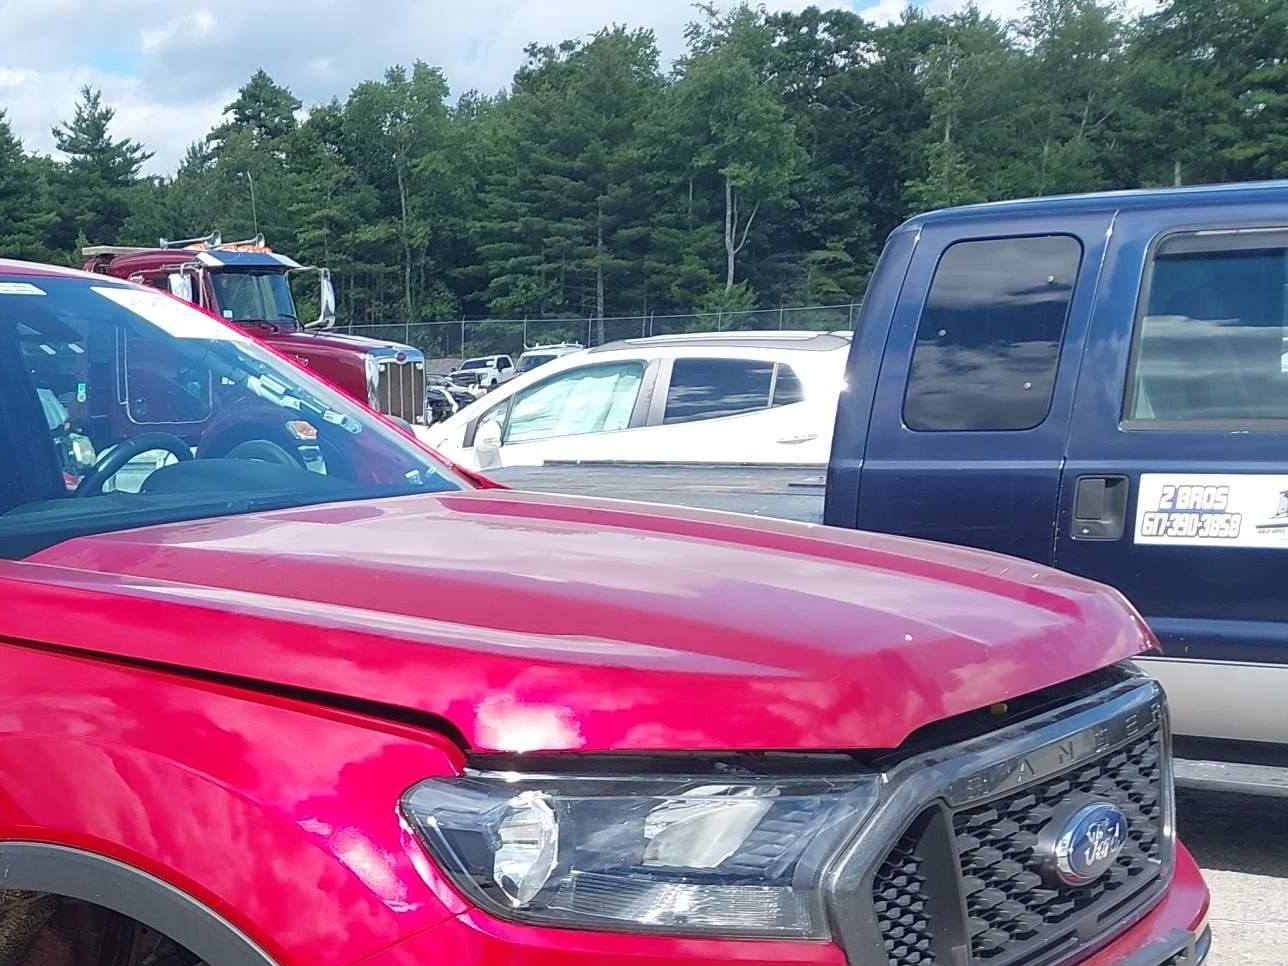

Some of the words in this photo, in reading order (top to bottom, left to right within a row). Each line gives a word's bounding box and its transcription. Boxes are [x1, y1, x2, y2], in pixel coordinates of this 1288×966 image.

[1159, 484, 1176, 511] 2
[1175, 484, 1230, 511] BROS
[1084, 818, 1121, 866] Ford
